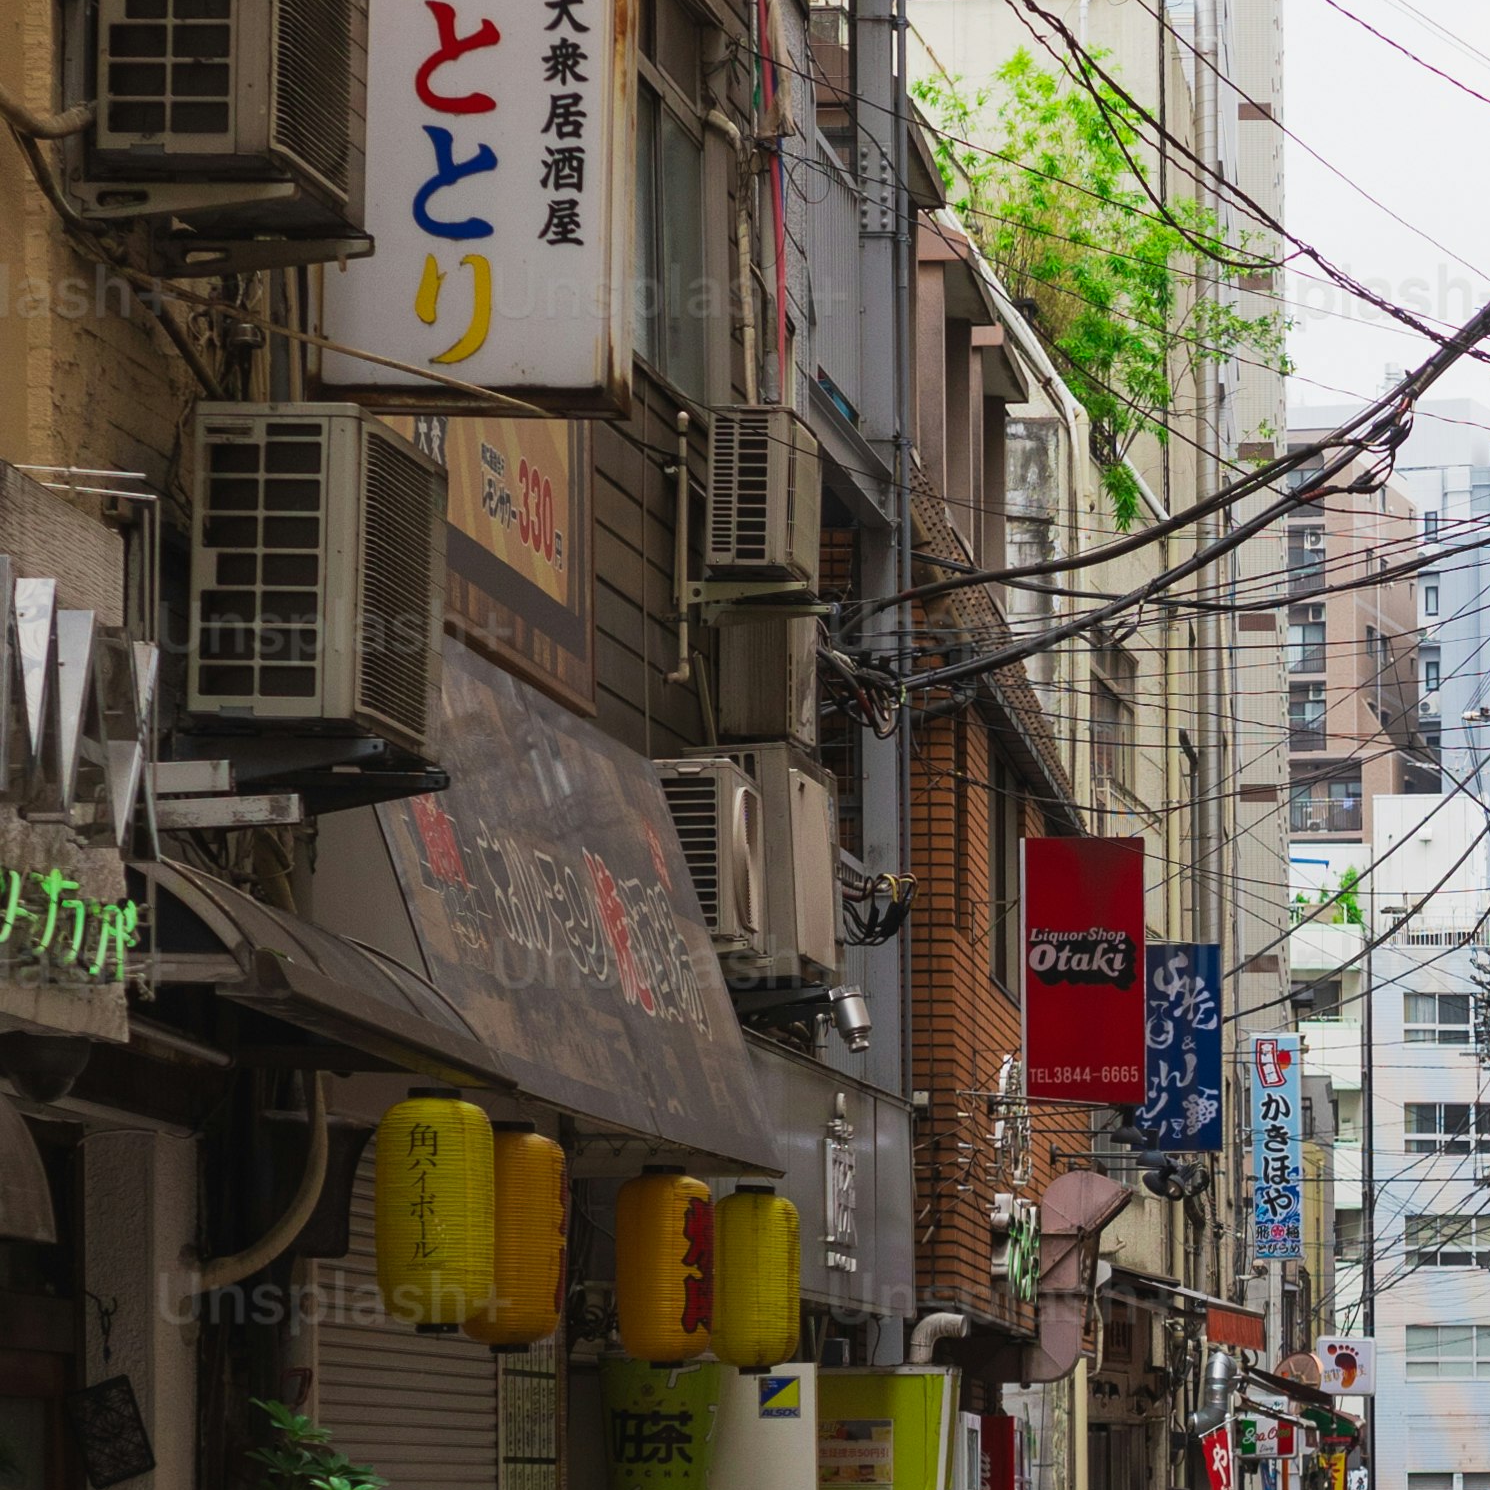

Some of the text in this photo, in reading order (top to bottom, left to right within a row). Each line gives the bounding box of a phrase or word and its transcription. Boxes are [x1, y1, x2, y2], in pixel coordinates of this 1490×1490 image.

[412, 0, 500, 365] ととり
[1029, 926, 1127, 947] Liquor Shop
[1029, 942, 1127, 978] Otaki
[406, 1122, 438, 1261] 角ハイボール
[1261, 1092, 1292, 1218] かきほや
